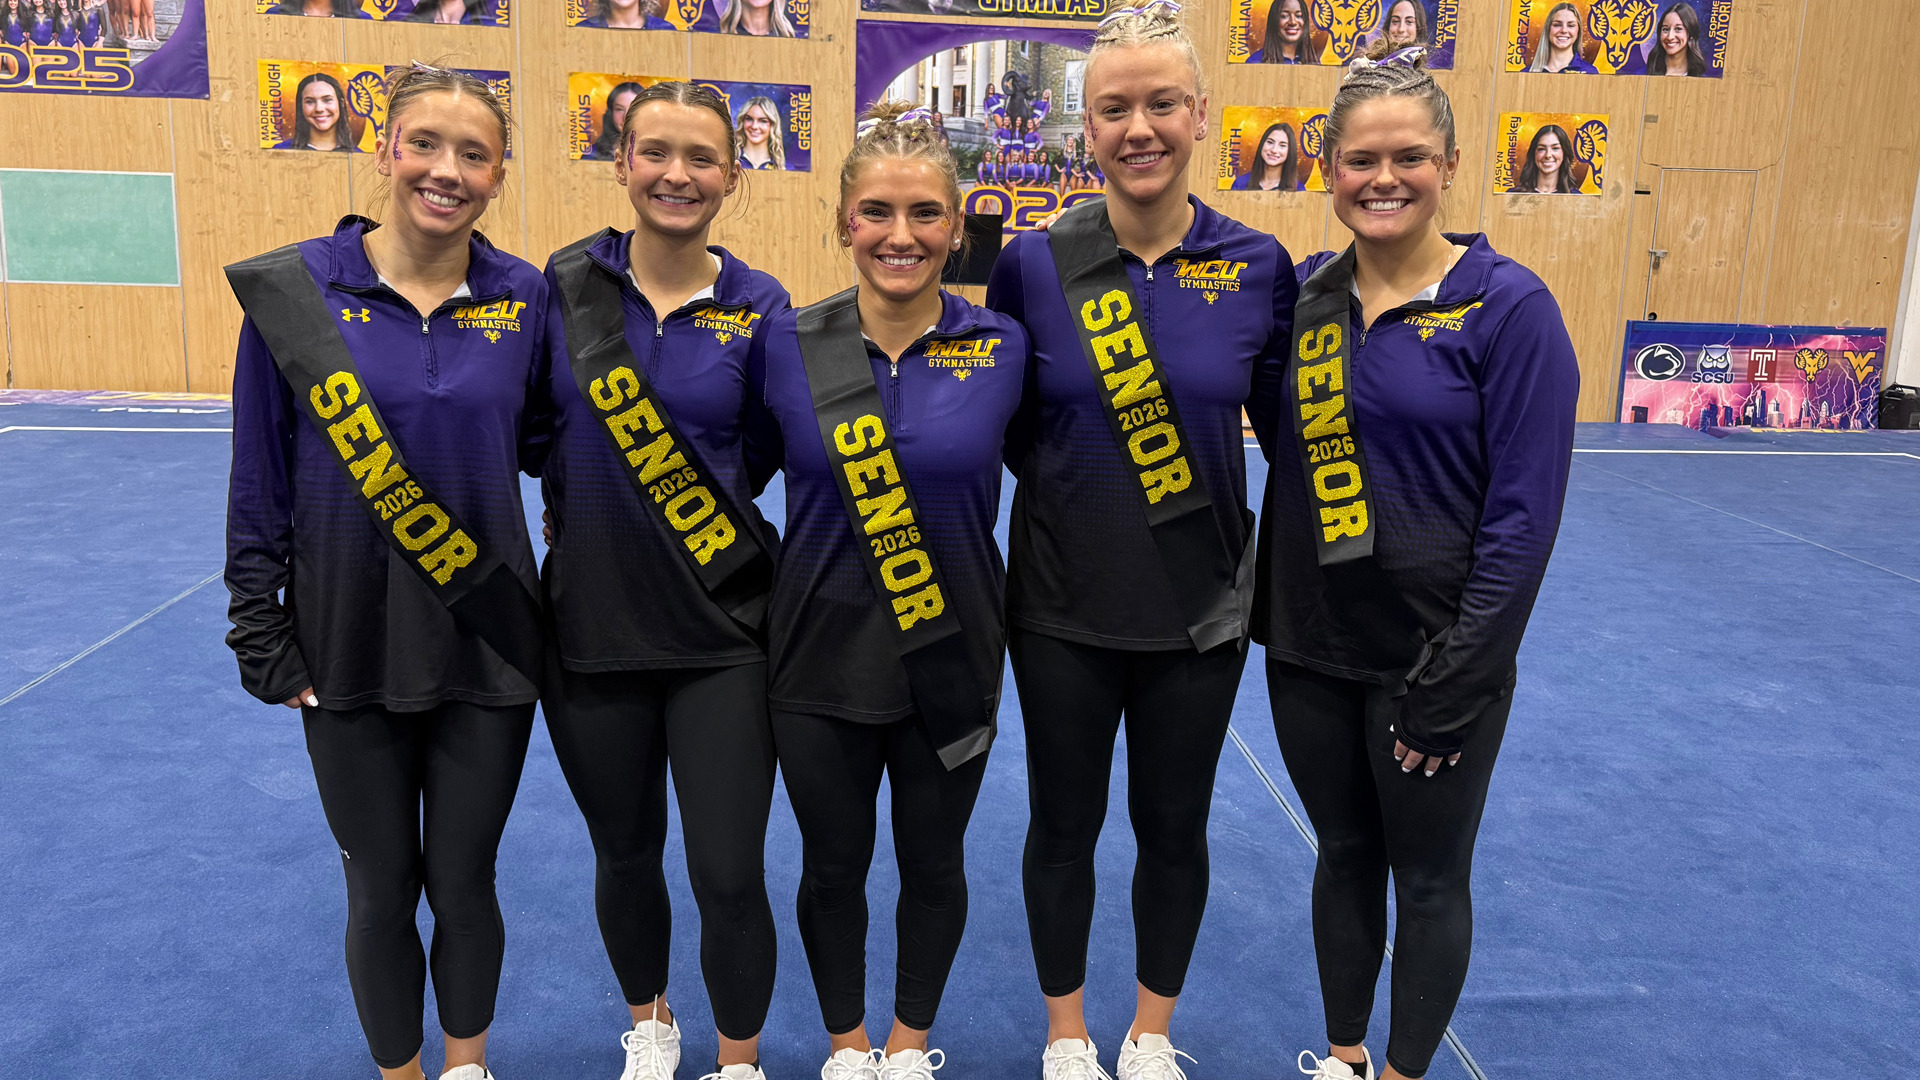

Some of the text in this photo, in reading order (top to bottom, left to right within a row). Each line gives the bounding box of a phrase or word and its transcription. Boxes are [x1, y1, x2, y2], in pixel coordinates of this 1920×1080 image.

[1515, 0, 1531, 65] SOBCZAK
[1708, 0, 1720, 38] SOPHIE
[1712, 2, 1732, 68] SALVATORI
[1228, 26, 1237, 56] ZIYAN
[1507, 40, 1515, 65] ALY
[261, 99, 270, 141] MADDIE
[270, 63, 281, 142] McCULLOUGH
[790, 92, 799, 133] BAILEY
[570, 110, 578, 153] HANNAH
[579, 94, 592, 155] ELKINS
[799, 92, 811, 151] GREENE
[1219, 140, 1229, 178] GIANNA
[1229, 128, 1242, 178] SMITH
[1495, 151, 1504, 187] JASLYN
[1173, 258, 1248, 280] WCU
[1179, 278, 1241, 292] GYMNASTICS
[457, 320, 521, 332] GYMNASTICS
[694, 318, 753, 339] GYMNASTICS
[923, 338, 1001, 359] WCU
[928, 358, 995, 368] GYMNASTICS
[1691, 372, 1734, 384] SCSU
[1118, 398, 1169, 432] 2026
[1307, 435, 1356, 463] 2026
[374, 480, 424, 521] 2026
[649, 466, 698, 504] 2026
[870, 525, 921, 558] 2026
